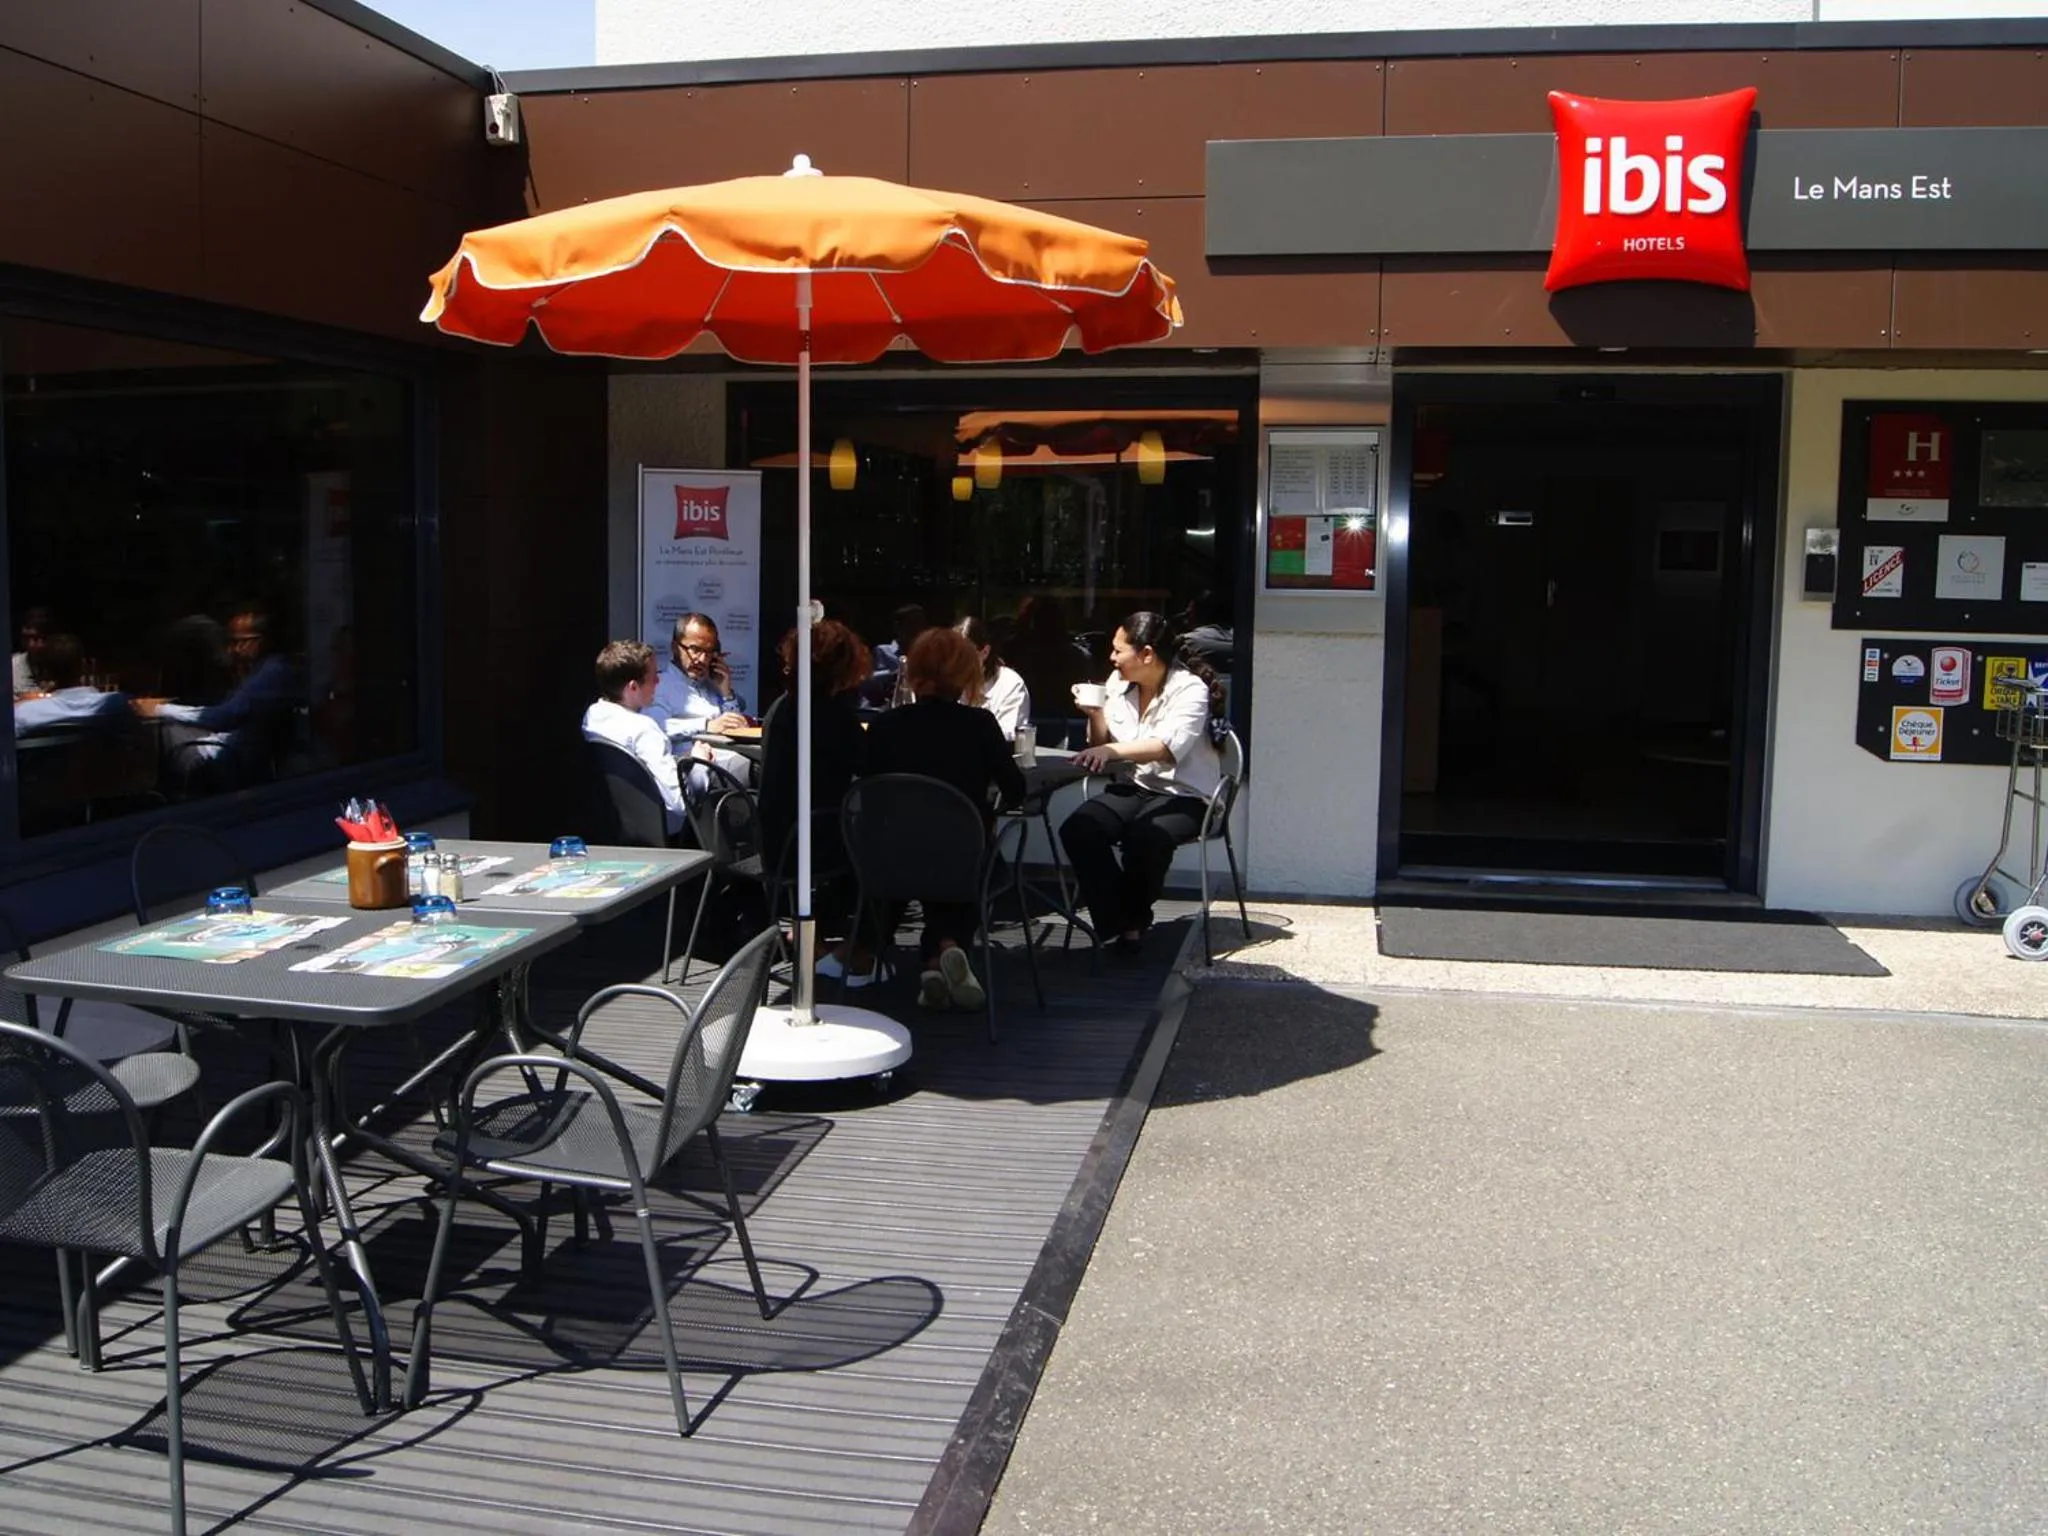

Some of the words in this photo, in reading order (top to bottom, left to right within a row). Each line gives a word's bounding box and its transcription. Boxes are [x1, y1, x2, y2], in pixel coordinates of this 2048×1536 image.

[1583, 135, 1727, 215] ibis
[1794, 177, 1825, 200] Le
[1833, 176, 1902, 200] Mans
[1911, 176, 1952, 199] Est
[1624, 236, 1685, 252] HOTELS
[1907, 431, 1942, 461] H
[683, 499, 721, 521] ibis
[1864, 551, 1903, 590] LICENCE
